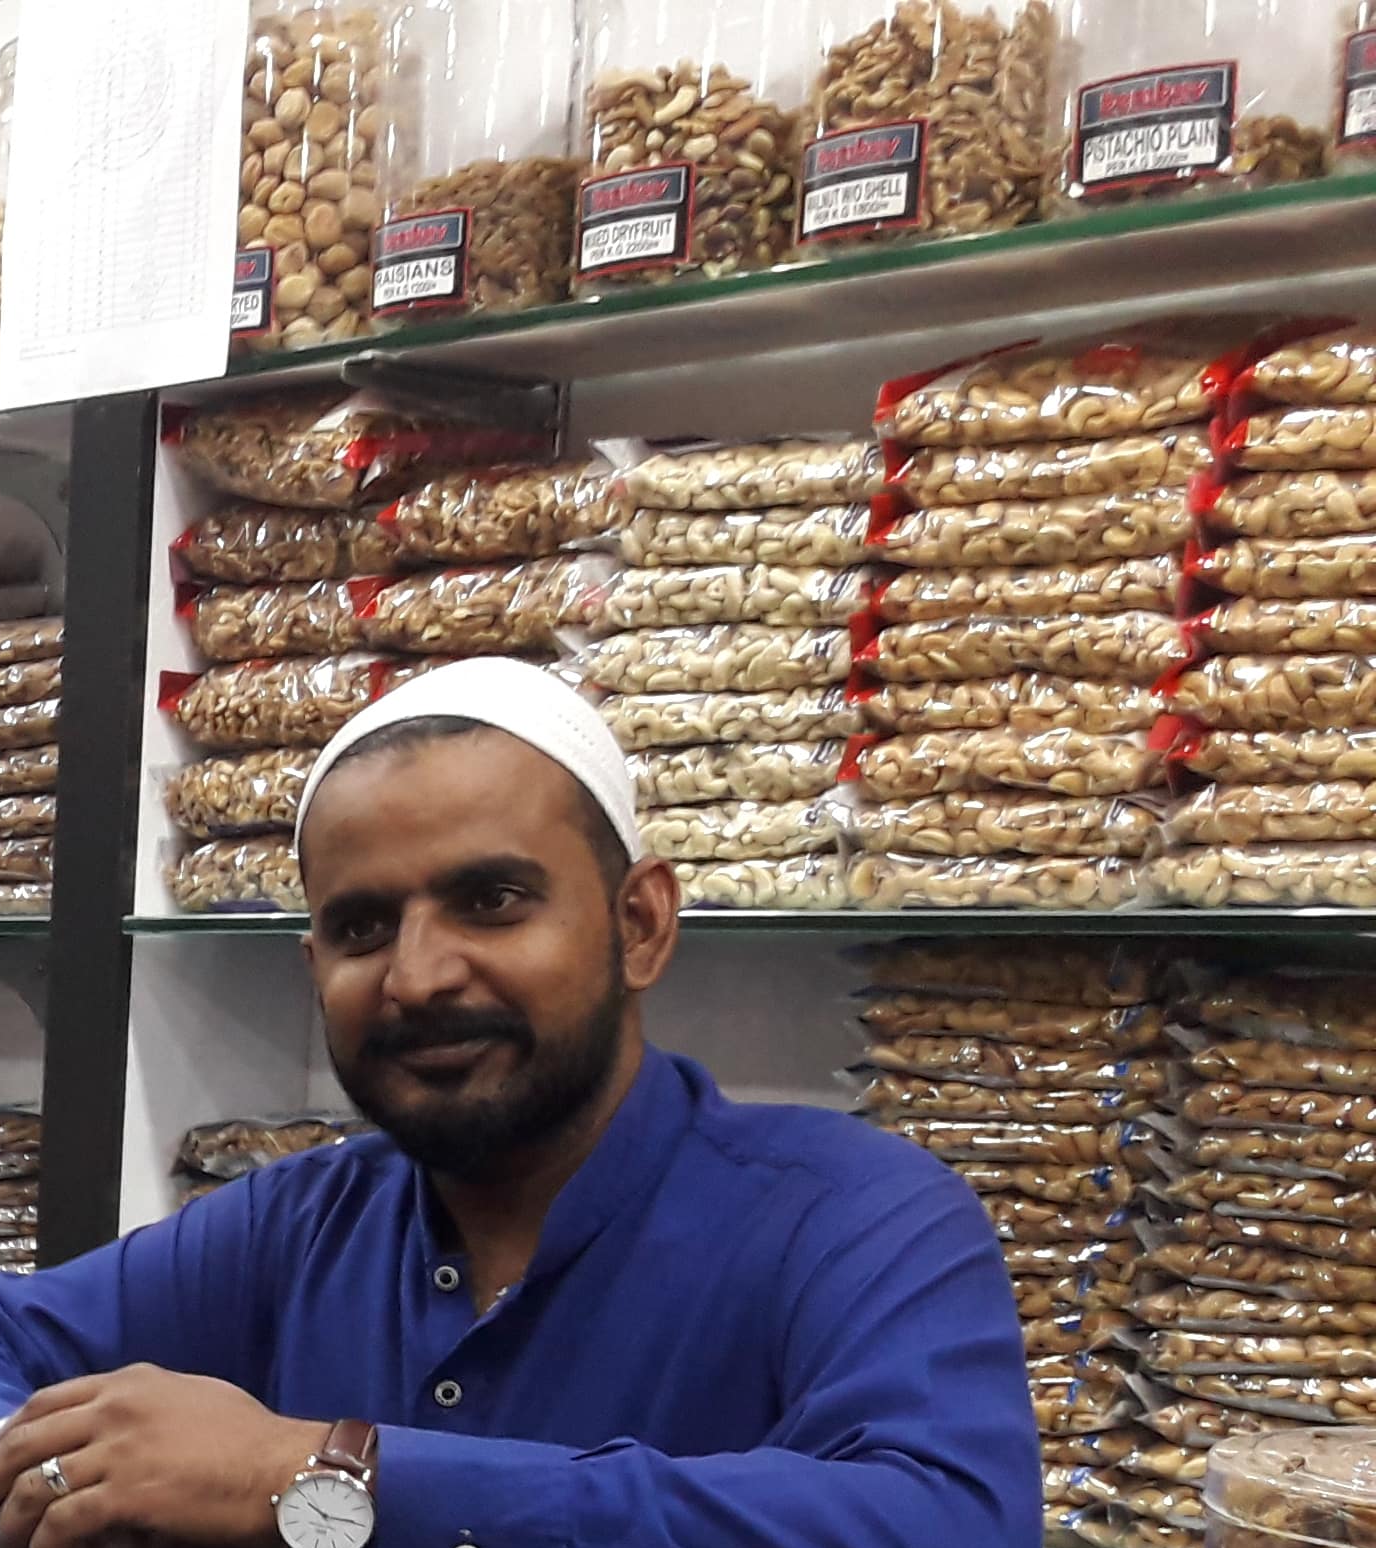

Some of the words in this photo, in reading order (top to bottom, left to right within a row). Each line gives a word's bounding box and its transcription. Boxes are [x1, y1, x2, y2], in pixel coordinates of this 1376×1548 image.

[1085, 127, 1162, 163] PISTACHIO
[1166, 119, 1216, 150] PLAIN
[611, 217, 673, 243] DRYFRUIT
